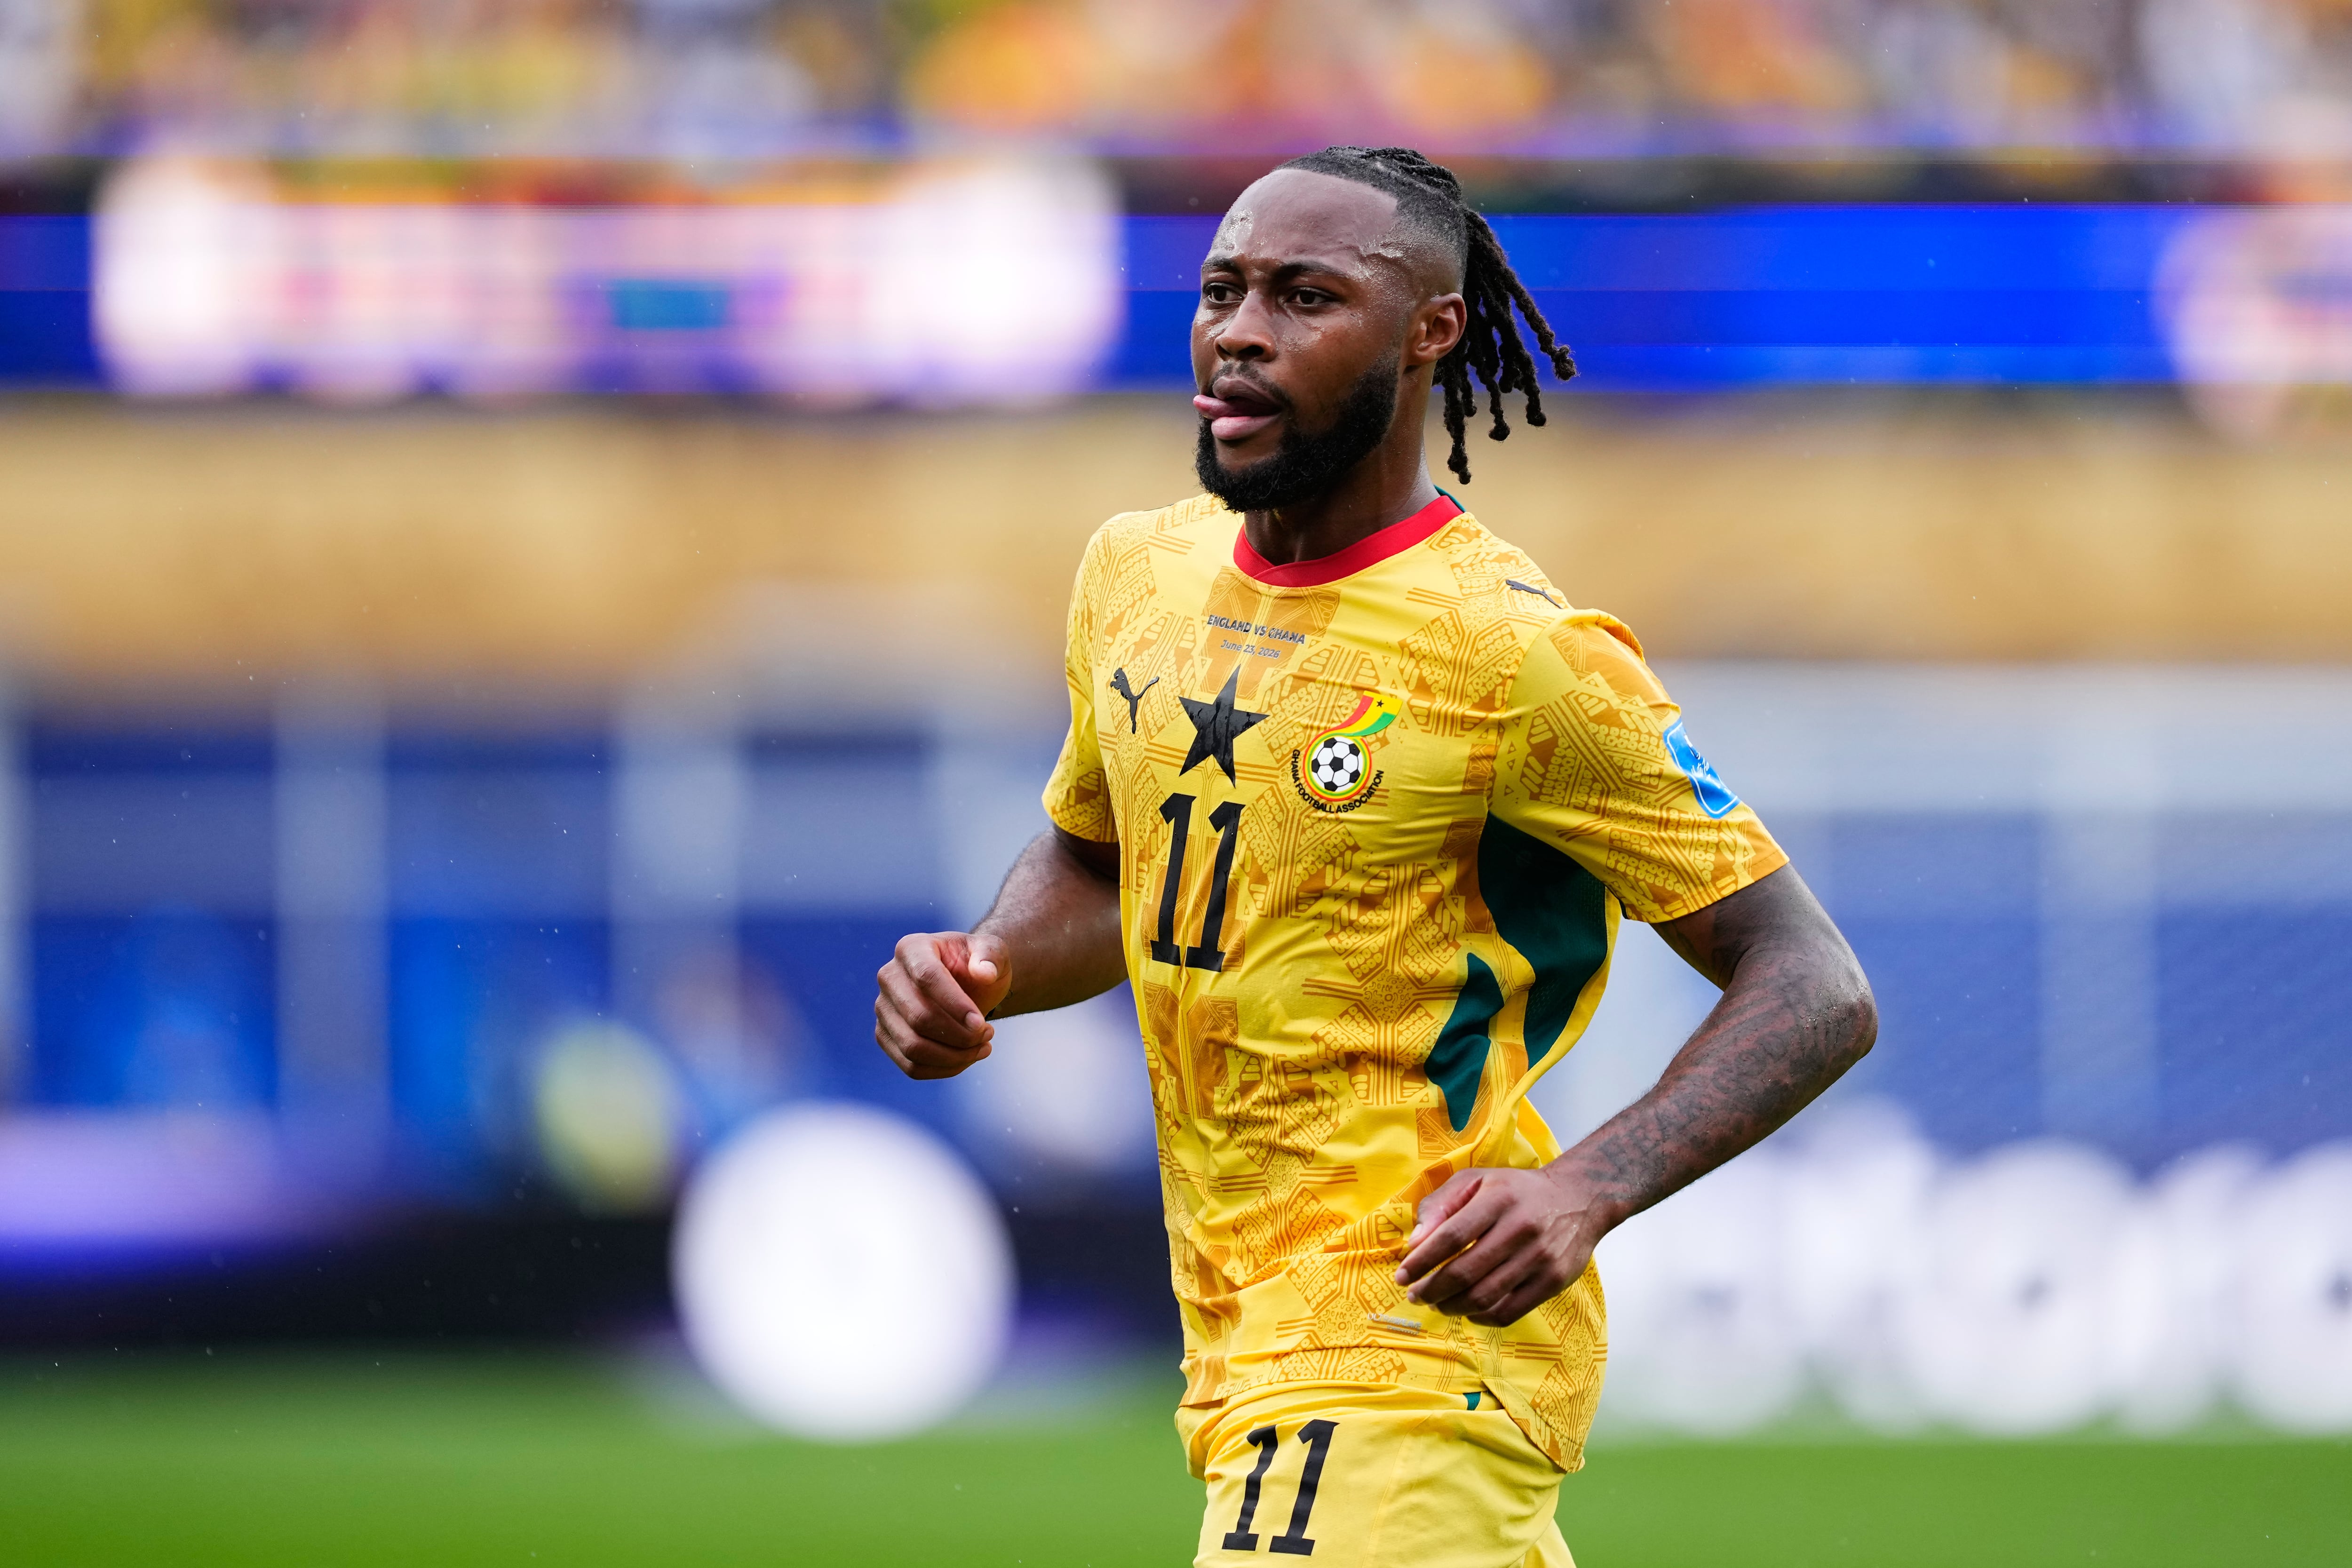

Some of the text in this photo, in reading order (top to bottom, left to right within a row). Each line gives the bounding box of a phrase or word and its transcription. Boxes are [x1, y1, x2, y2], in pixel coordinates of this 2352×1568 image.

[1207, 614, 1305, 645] ENGLAND VS GHANA
[1220, 639, 1281, 659] June 23, 2026
[1291, 749, 1384, 813] GHANA FOOTBALL ASSOCIATION
[1150, 792, 1246, 972] 11
[1222, 1419, 1341, 1556] 11
